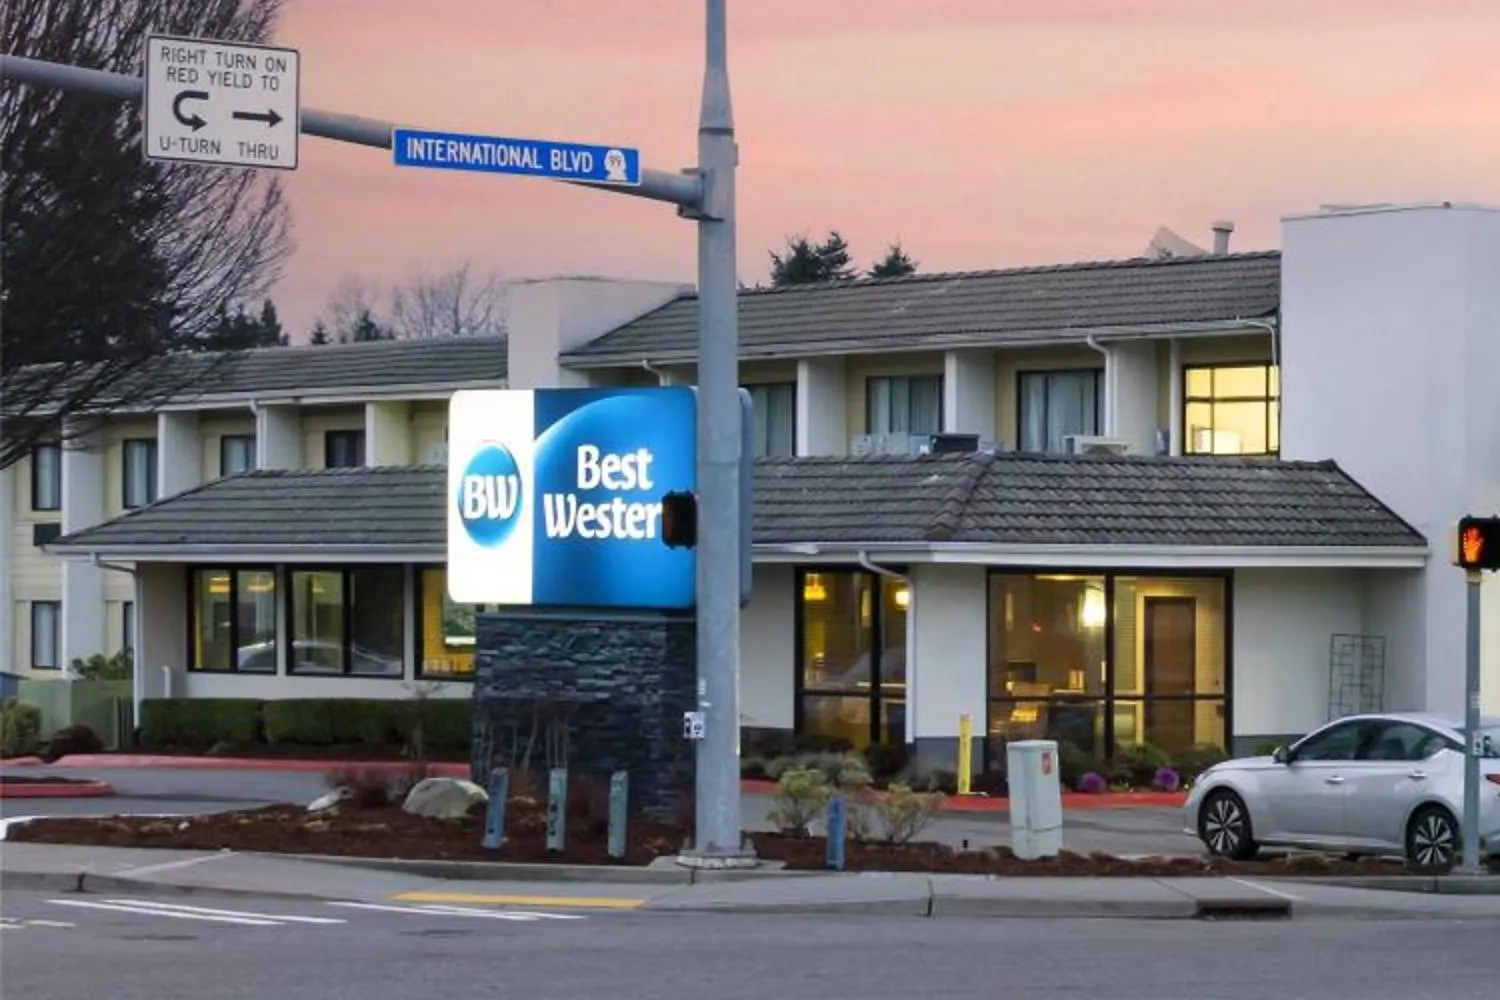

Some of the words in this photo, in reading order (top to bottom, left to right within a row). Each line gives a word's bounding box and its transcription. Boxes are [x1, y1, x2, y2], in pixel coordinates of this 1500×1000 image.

[160, 46, 207, 65] RIGHT
[215, 51, 256, 70] TURN
[265, 57, 287, 72] ON
[166, 66, 199, 83] RED
[207, 70, 252, 88] YIELD
[261, 75, 280, 91] TO
[159, 136, 221, 155] U-TURN
[238, 142, 279, 160] THRU
[406, 137, 543, 169] INTERNATIONAL
[550, 149, 594, 173] BLVD
[576, 444, 653, 491] Best
[463, 474, 519, 520] BW
[543, 493, 663, 539] Wester
